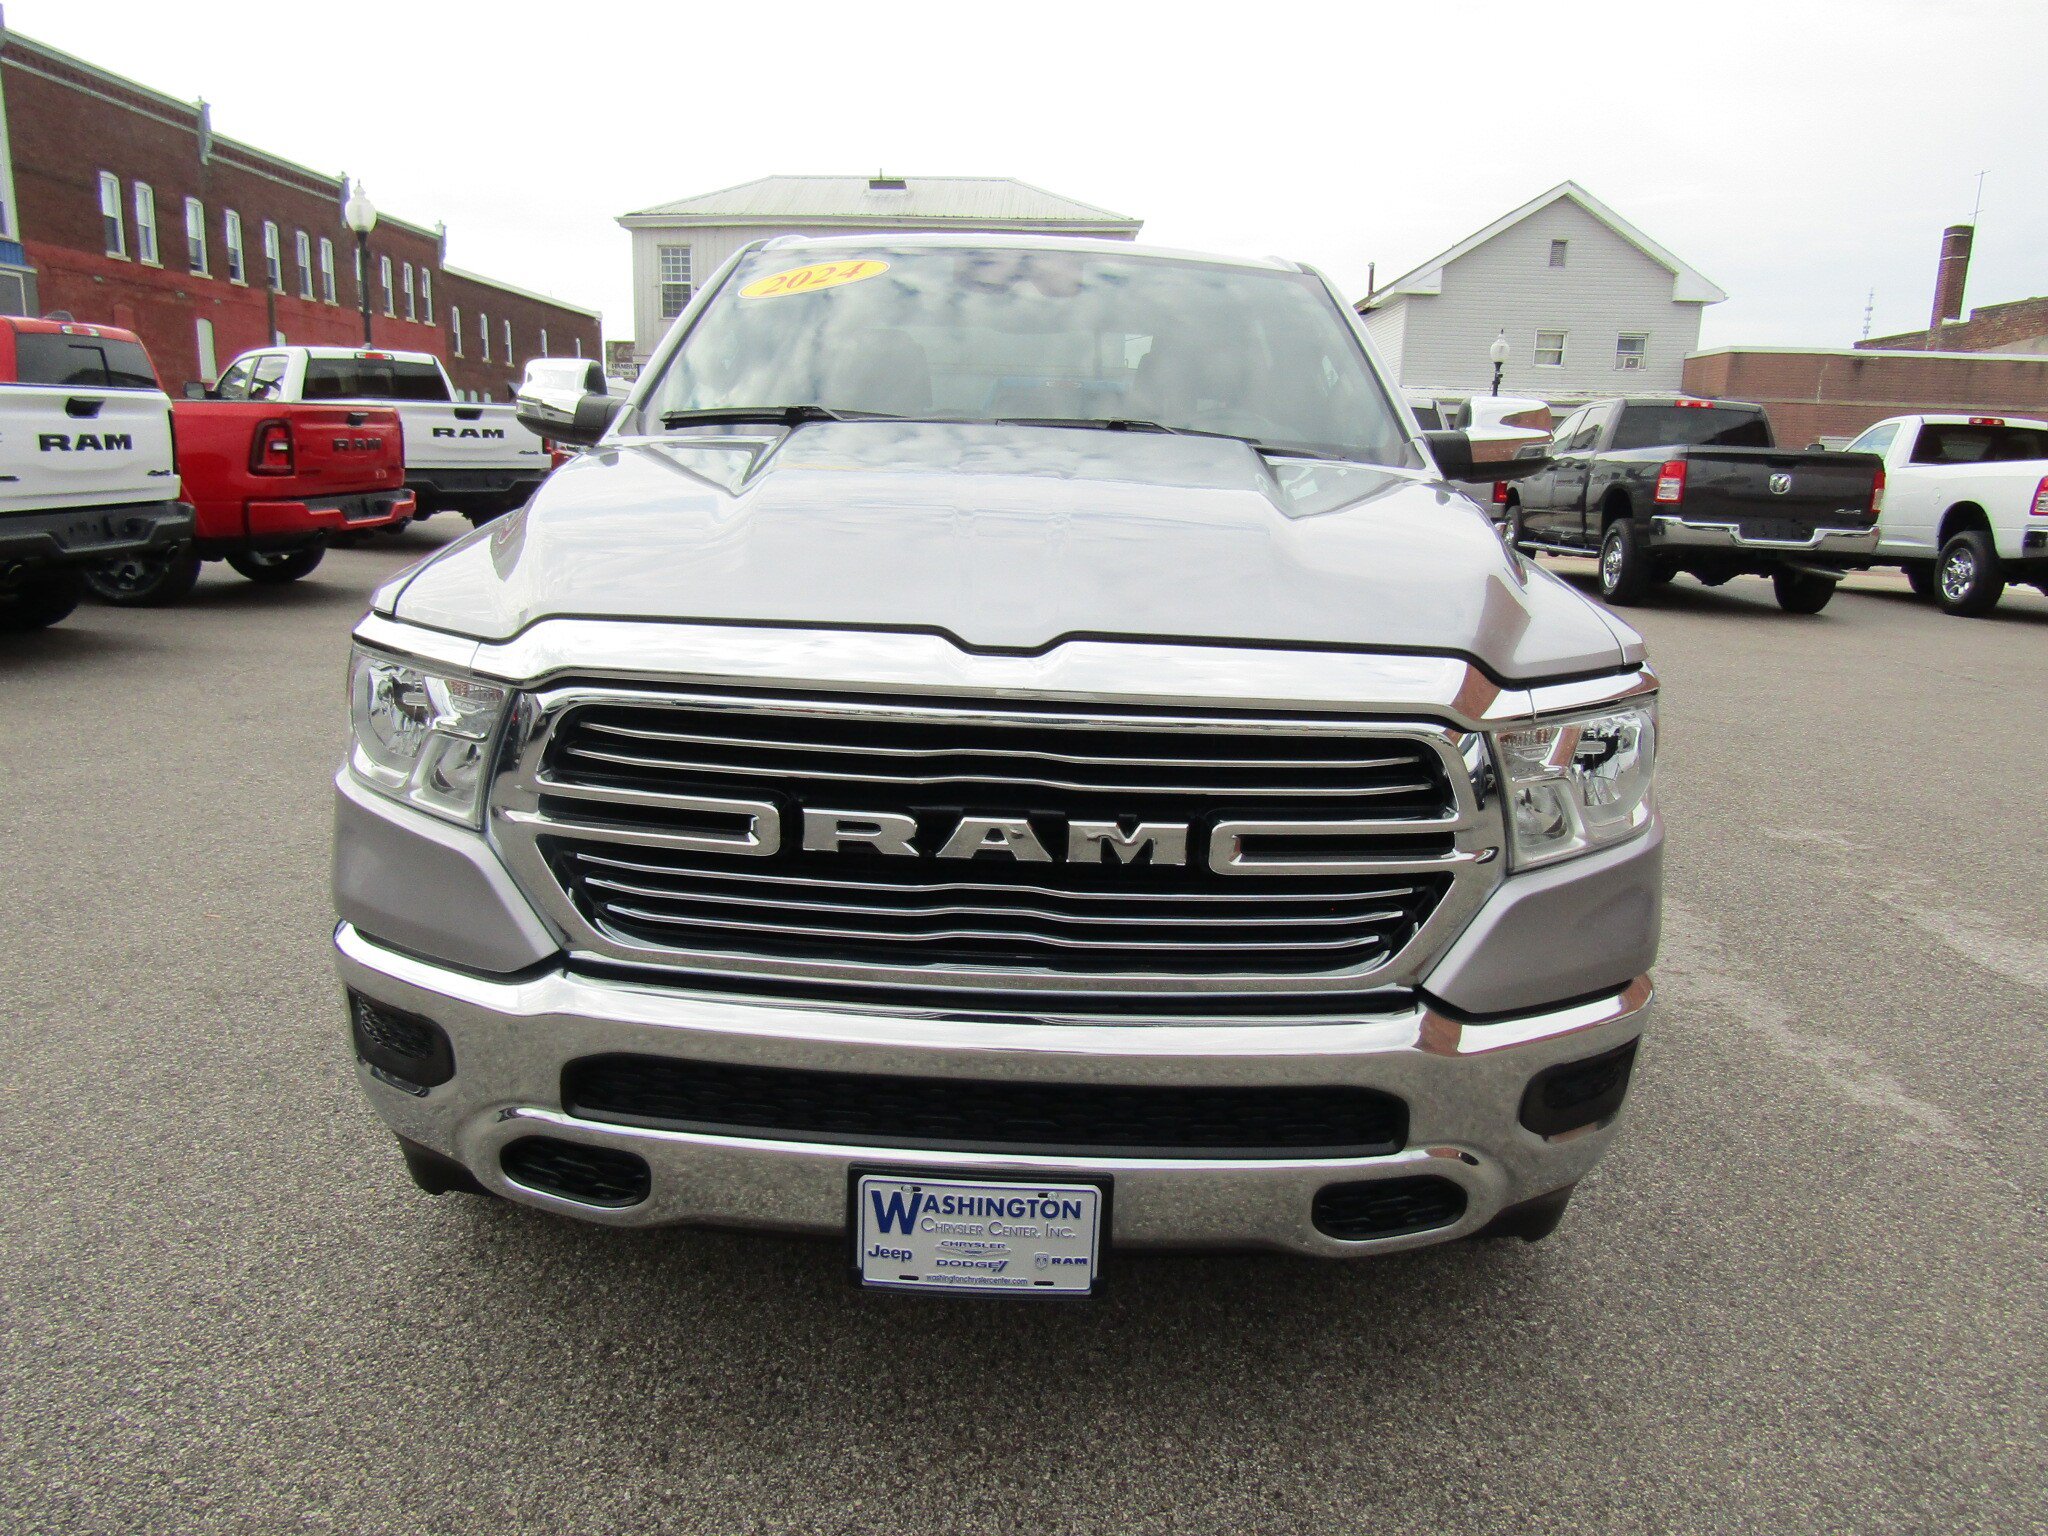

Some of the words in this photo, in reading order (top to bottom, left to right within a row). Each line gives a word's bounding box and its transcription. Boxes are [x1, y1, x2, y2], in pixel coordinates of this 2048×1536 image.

[760, 261, 866, 295] 2024
[432, 427, 505, 439] RAM
[38, 433, 133, 452] RAM
[332, 437, 382, 452] RAM
[802, 807, 1189, 866] RAM
[870, 1189, 1082, 1236] WASHINGTON
[920, 1217, 984, 1237] CHRYSLER
[1045, 1222, 1077, 1239] INC.
[867, 1244, 913, 1263] Jeep
[940, 1240, 1007, 1250] CHRYSLER
[935, 1258, 1002, 1270] DODGE
[1051, 1256, 1088, 1265] RAM
[925, 1273, 1029, 1286] washingtonchryslercenter.com
